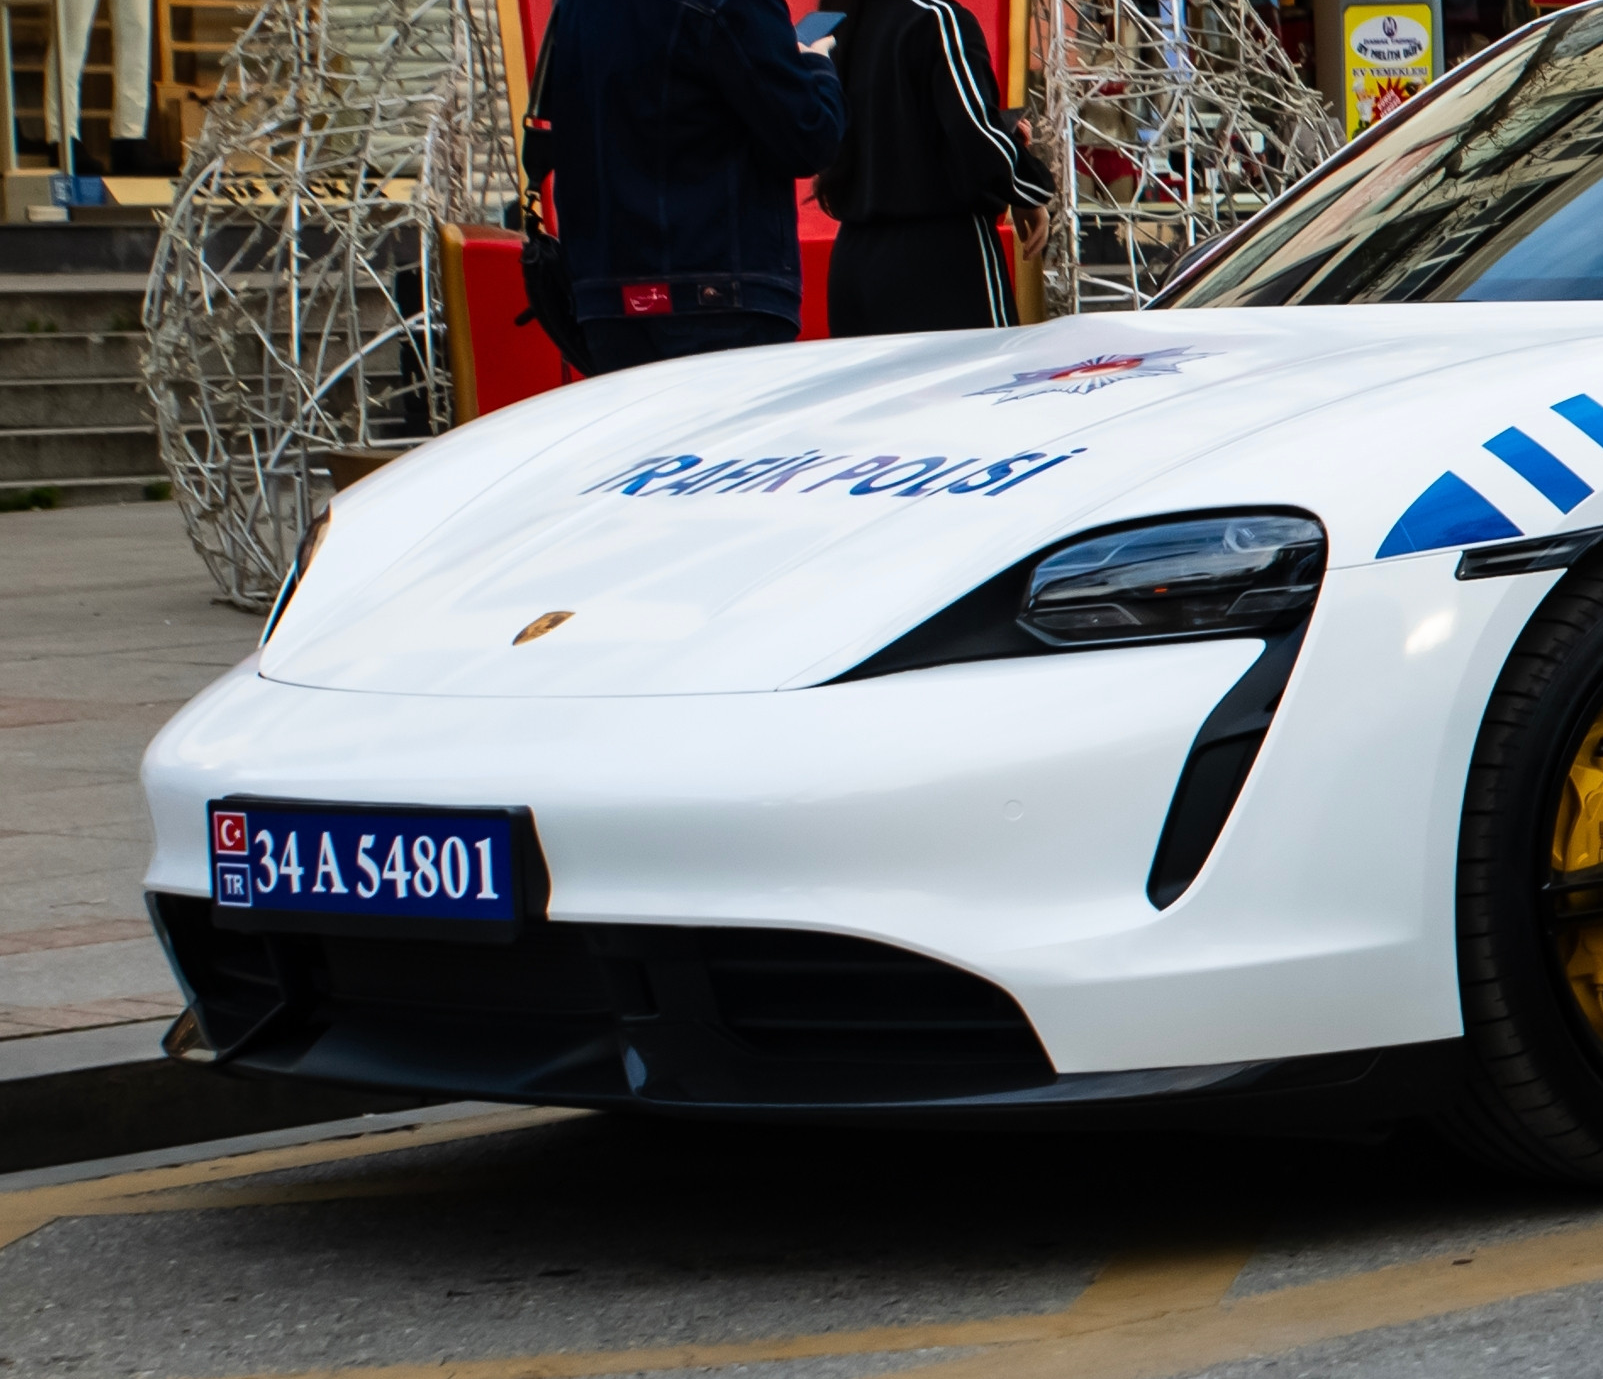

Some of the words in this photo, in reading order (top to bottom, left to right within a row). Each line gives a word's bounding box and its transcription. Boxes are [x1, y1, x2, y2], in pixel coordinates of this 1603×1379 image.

[578, 449, 856, 497] TRAFİK
[223, 873, 245, 896] TR
[254, 829, 305, 894] 34
[311, 831, 349, 894] A
[356, 833, 500, 899] 54801
